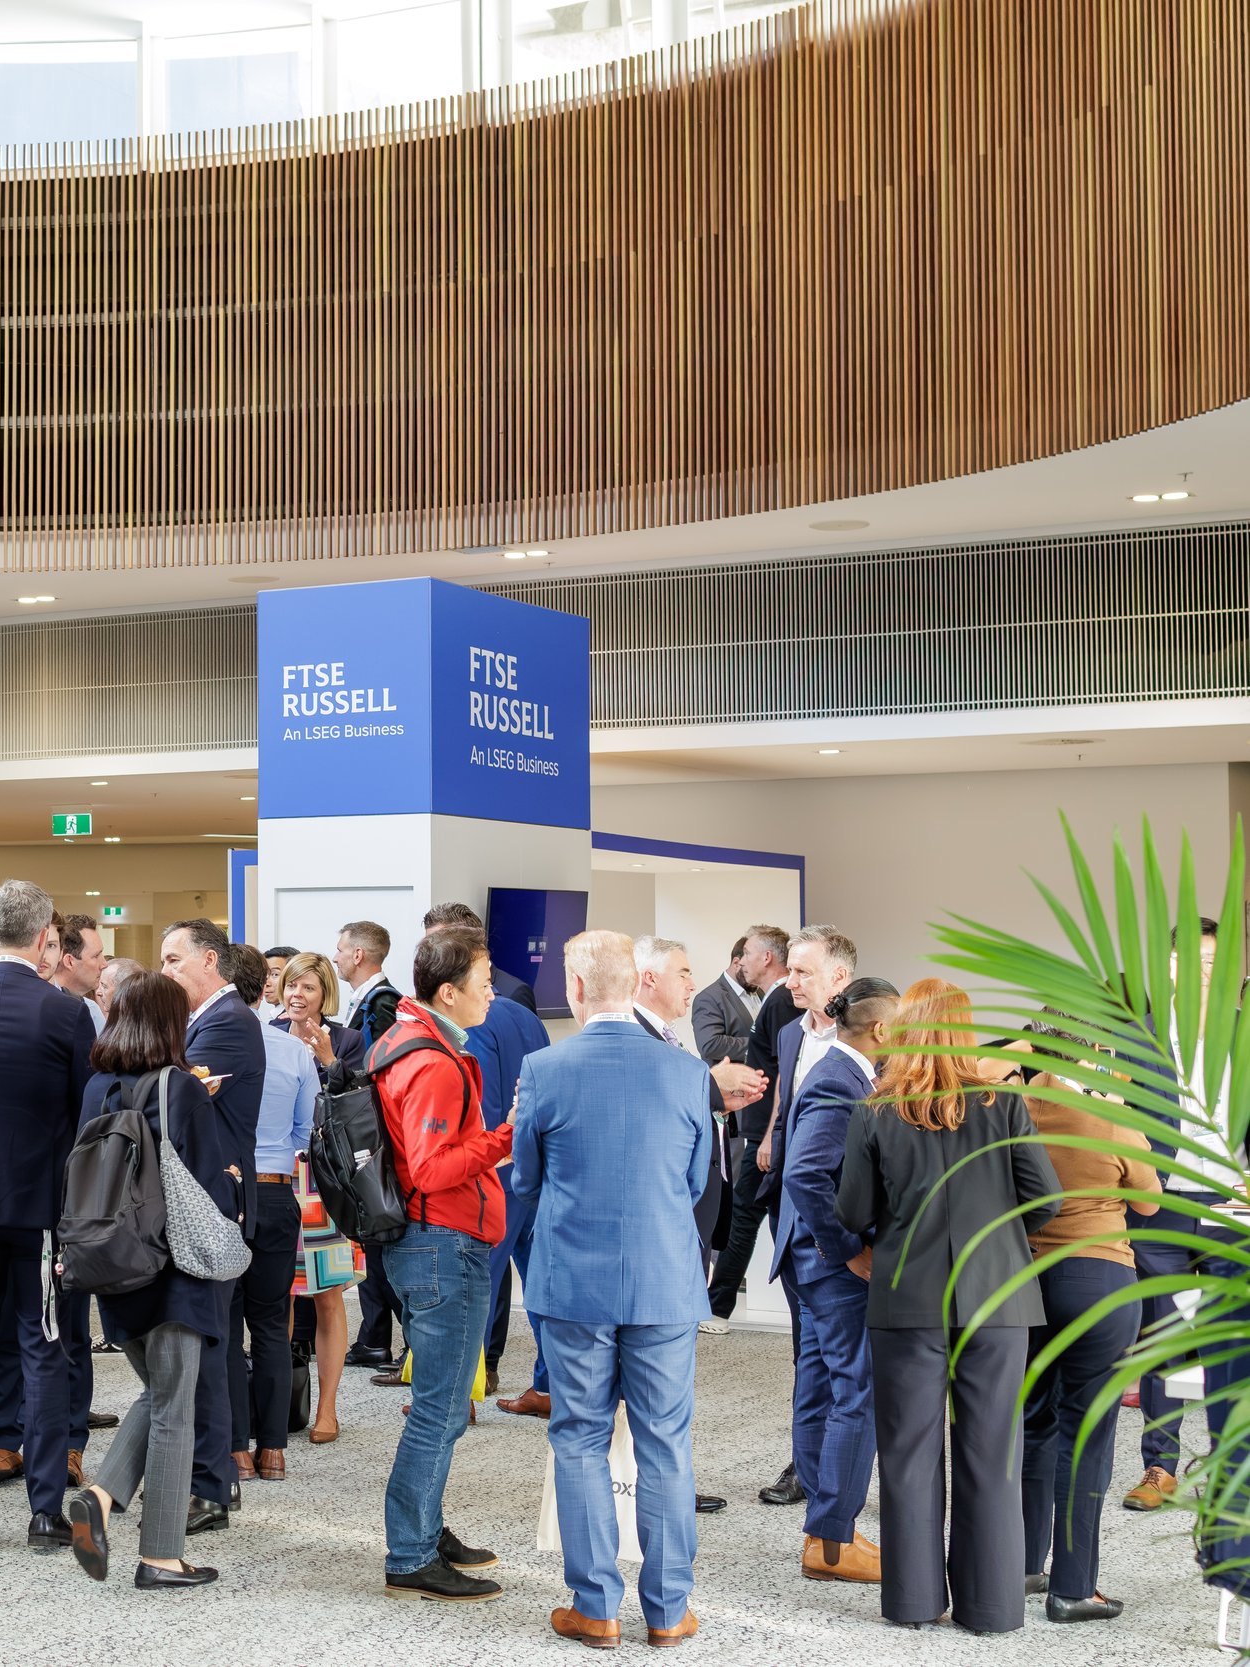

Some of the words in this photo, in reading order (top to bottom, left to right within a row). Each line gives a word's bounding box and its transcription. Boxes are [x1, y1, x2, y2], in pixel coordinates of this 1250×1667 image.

[282, 663, 346, 688] FTSE
[470, 646, 518, 691] FTSE
[282, 688, 397, 717] RUSSELL
[470, 691, 554, 740] RUSSELL
[283, 728, 301, 741] An
[305, 726, 341, 740] LSEG
[344, 724, 405, 738] Business
[470, 745, 485, 766] An
[488, 748, 515, 770] LSEG
[518, 752, 559, 777] Business
